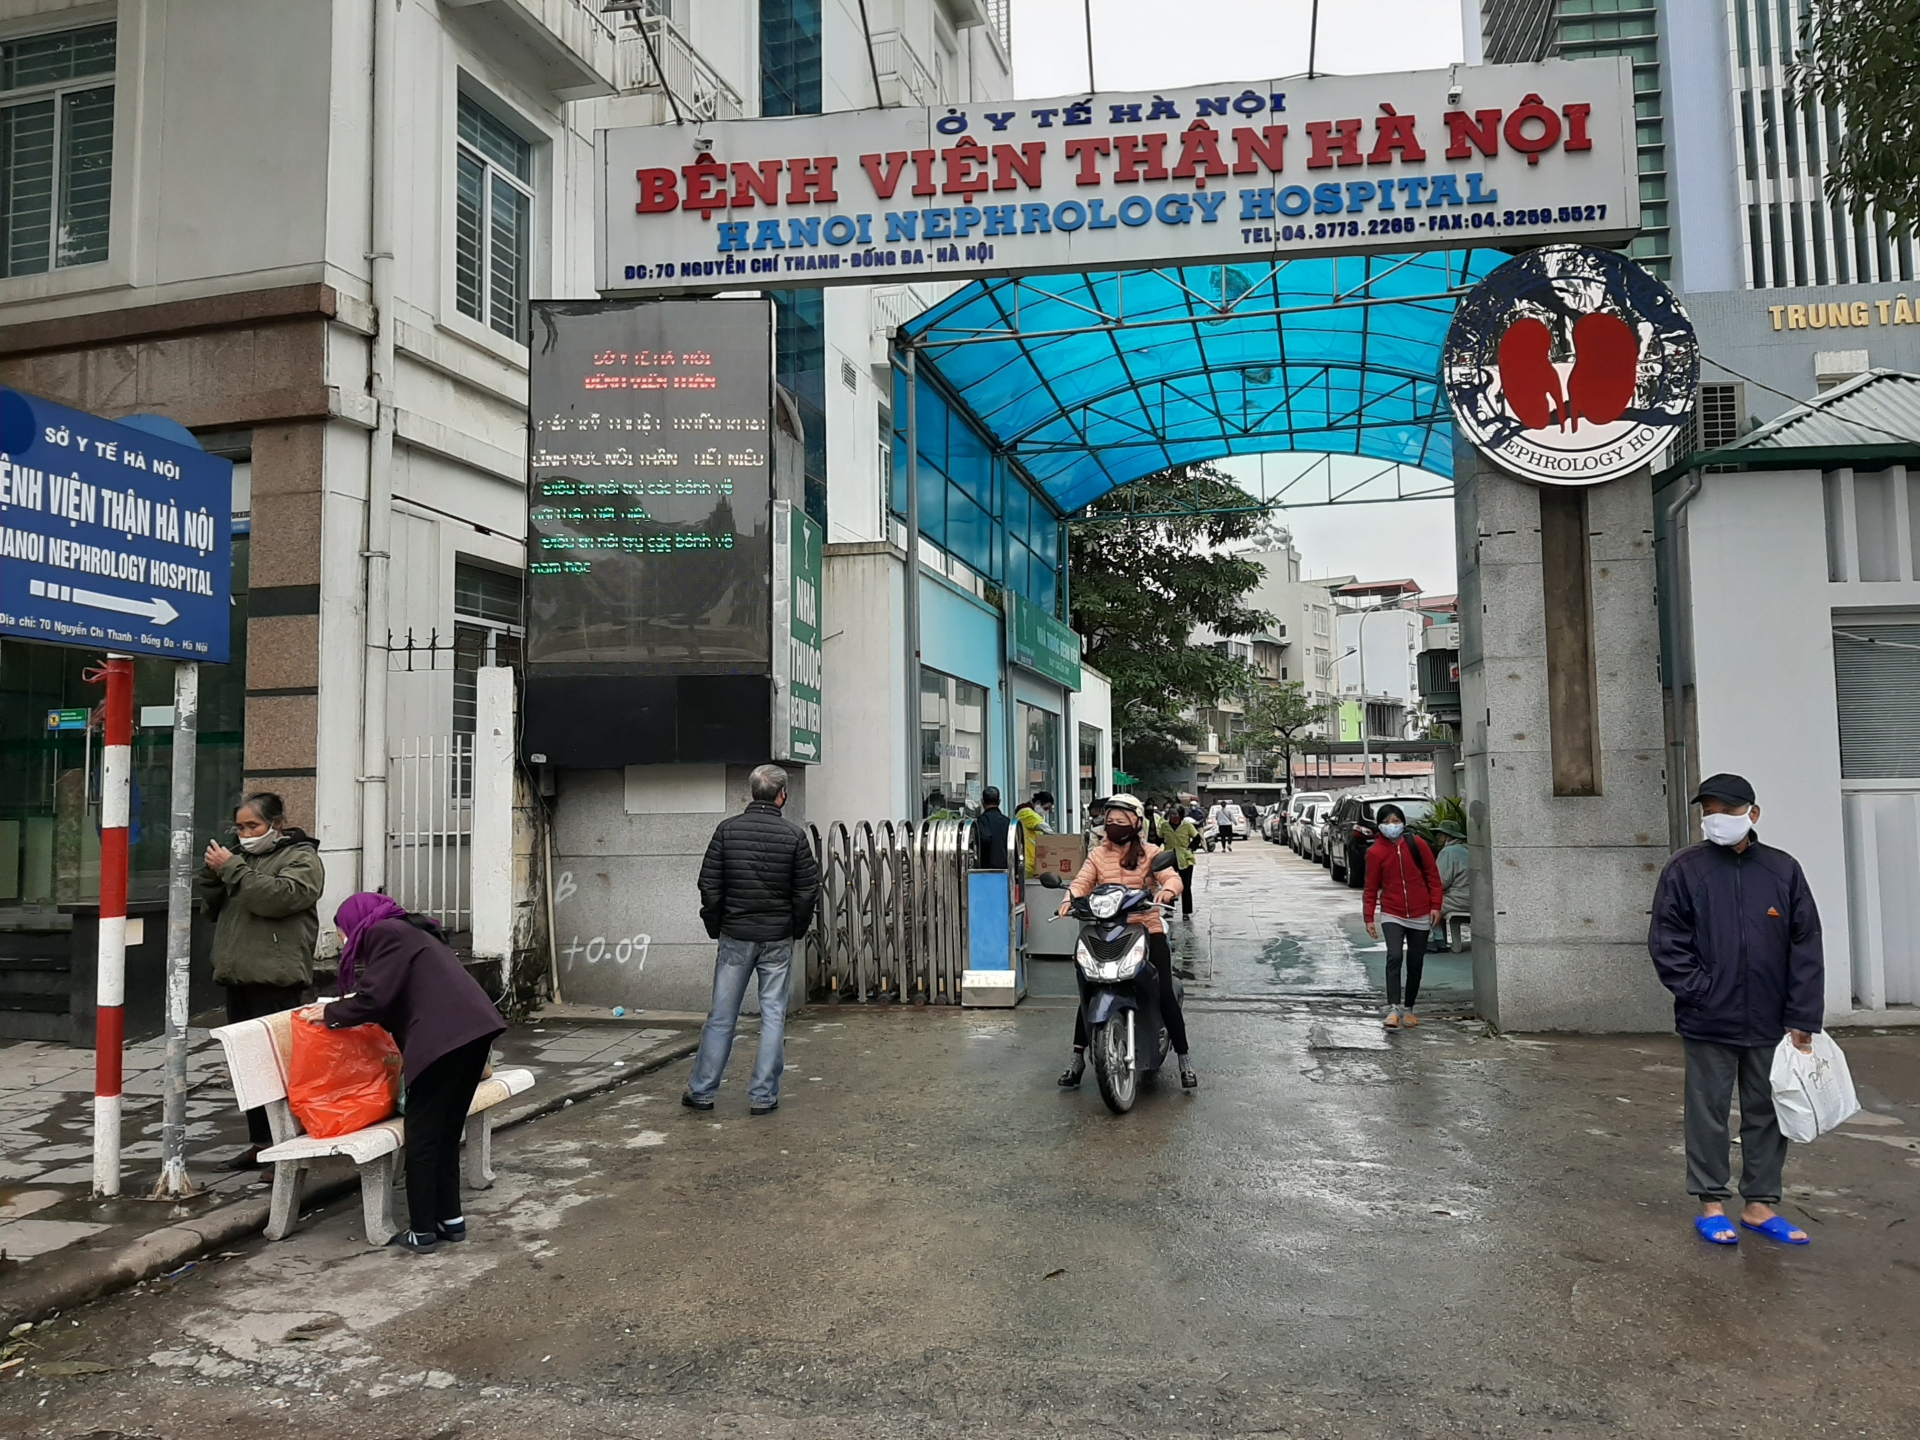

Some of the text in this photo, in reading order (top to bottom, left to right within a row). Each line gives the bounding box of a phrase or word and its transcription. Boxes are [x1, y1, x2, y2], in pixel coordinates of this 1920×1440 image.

[984, 112, 1015, 131] Y
[1031, 98, 1093, 128] TẾ
[1109, 95, 1180, 125] HÀ
[1196, 89, 1286, 118] NỘI
[635, 93, 1592, 220] BỆNH VIỆN THẬN HÀ NỘI
[717, 172, 1498, 251] HANOI NEPHROLOGY HOSPITAL
[680, 254, 746, 276] NGUYỄN
[751, 254, 780, 273] CHÍ
[965, 241, 993, 264] NỘI
[1768, 293, 1920, 330] TRUNG TÂ
[45, 425, 180, 481] SỞ Y TẾ HÀ NỘI
[1502, 426, 1660, 471] EPHROLOGY HO
[49, 471, 95, 527] VIỆN
[101, 488, 151, 540] THẬN
[155, 499, 179, 544] HÀ
[184, 507, 214, 557] NỘI
[49, 537, 147, 584] NEPHROLOGY
[150, 559, 213, 596] HOSPITAL
[796, 576, 816, 629] NHÀ
[39, 618, 51, 630] 70
[54, 621, 87, 636] Nguyễn
[107, 628, 133, 642] Thanh
[141, 633, 161, 648] Đống
[195, 641, 208, 653] Nội
[791, 632, 820, 691] THUỐC
[791, 690, 820, 739] BỆNH VIỆN
[562, 933, 651, 972] +0.09
